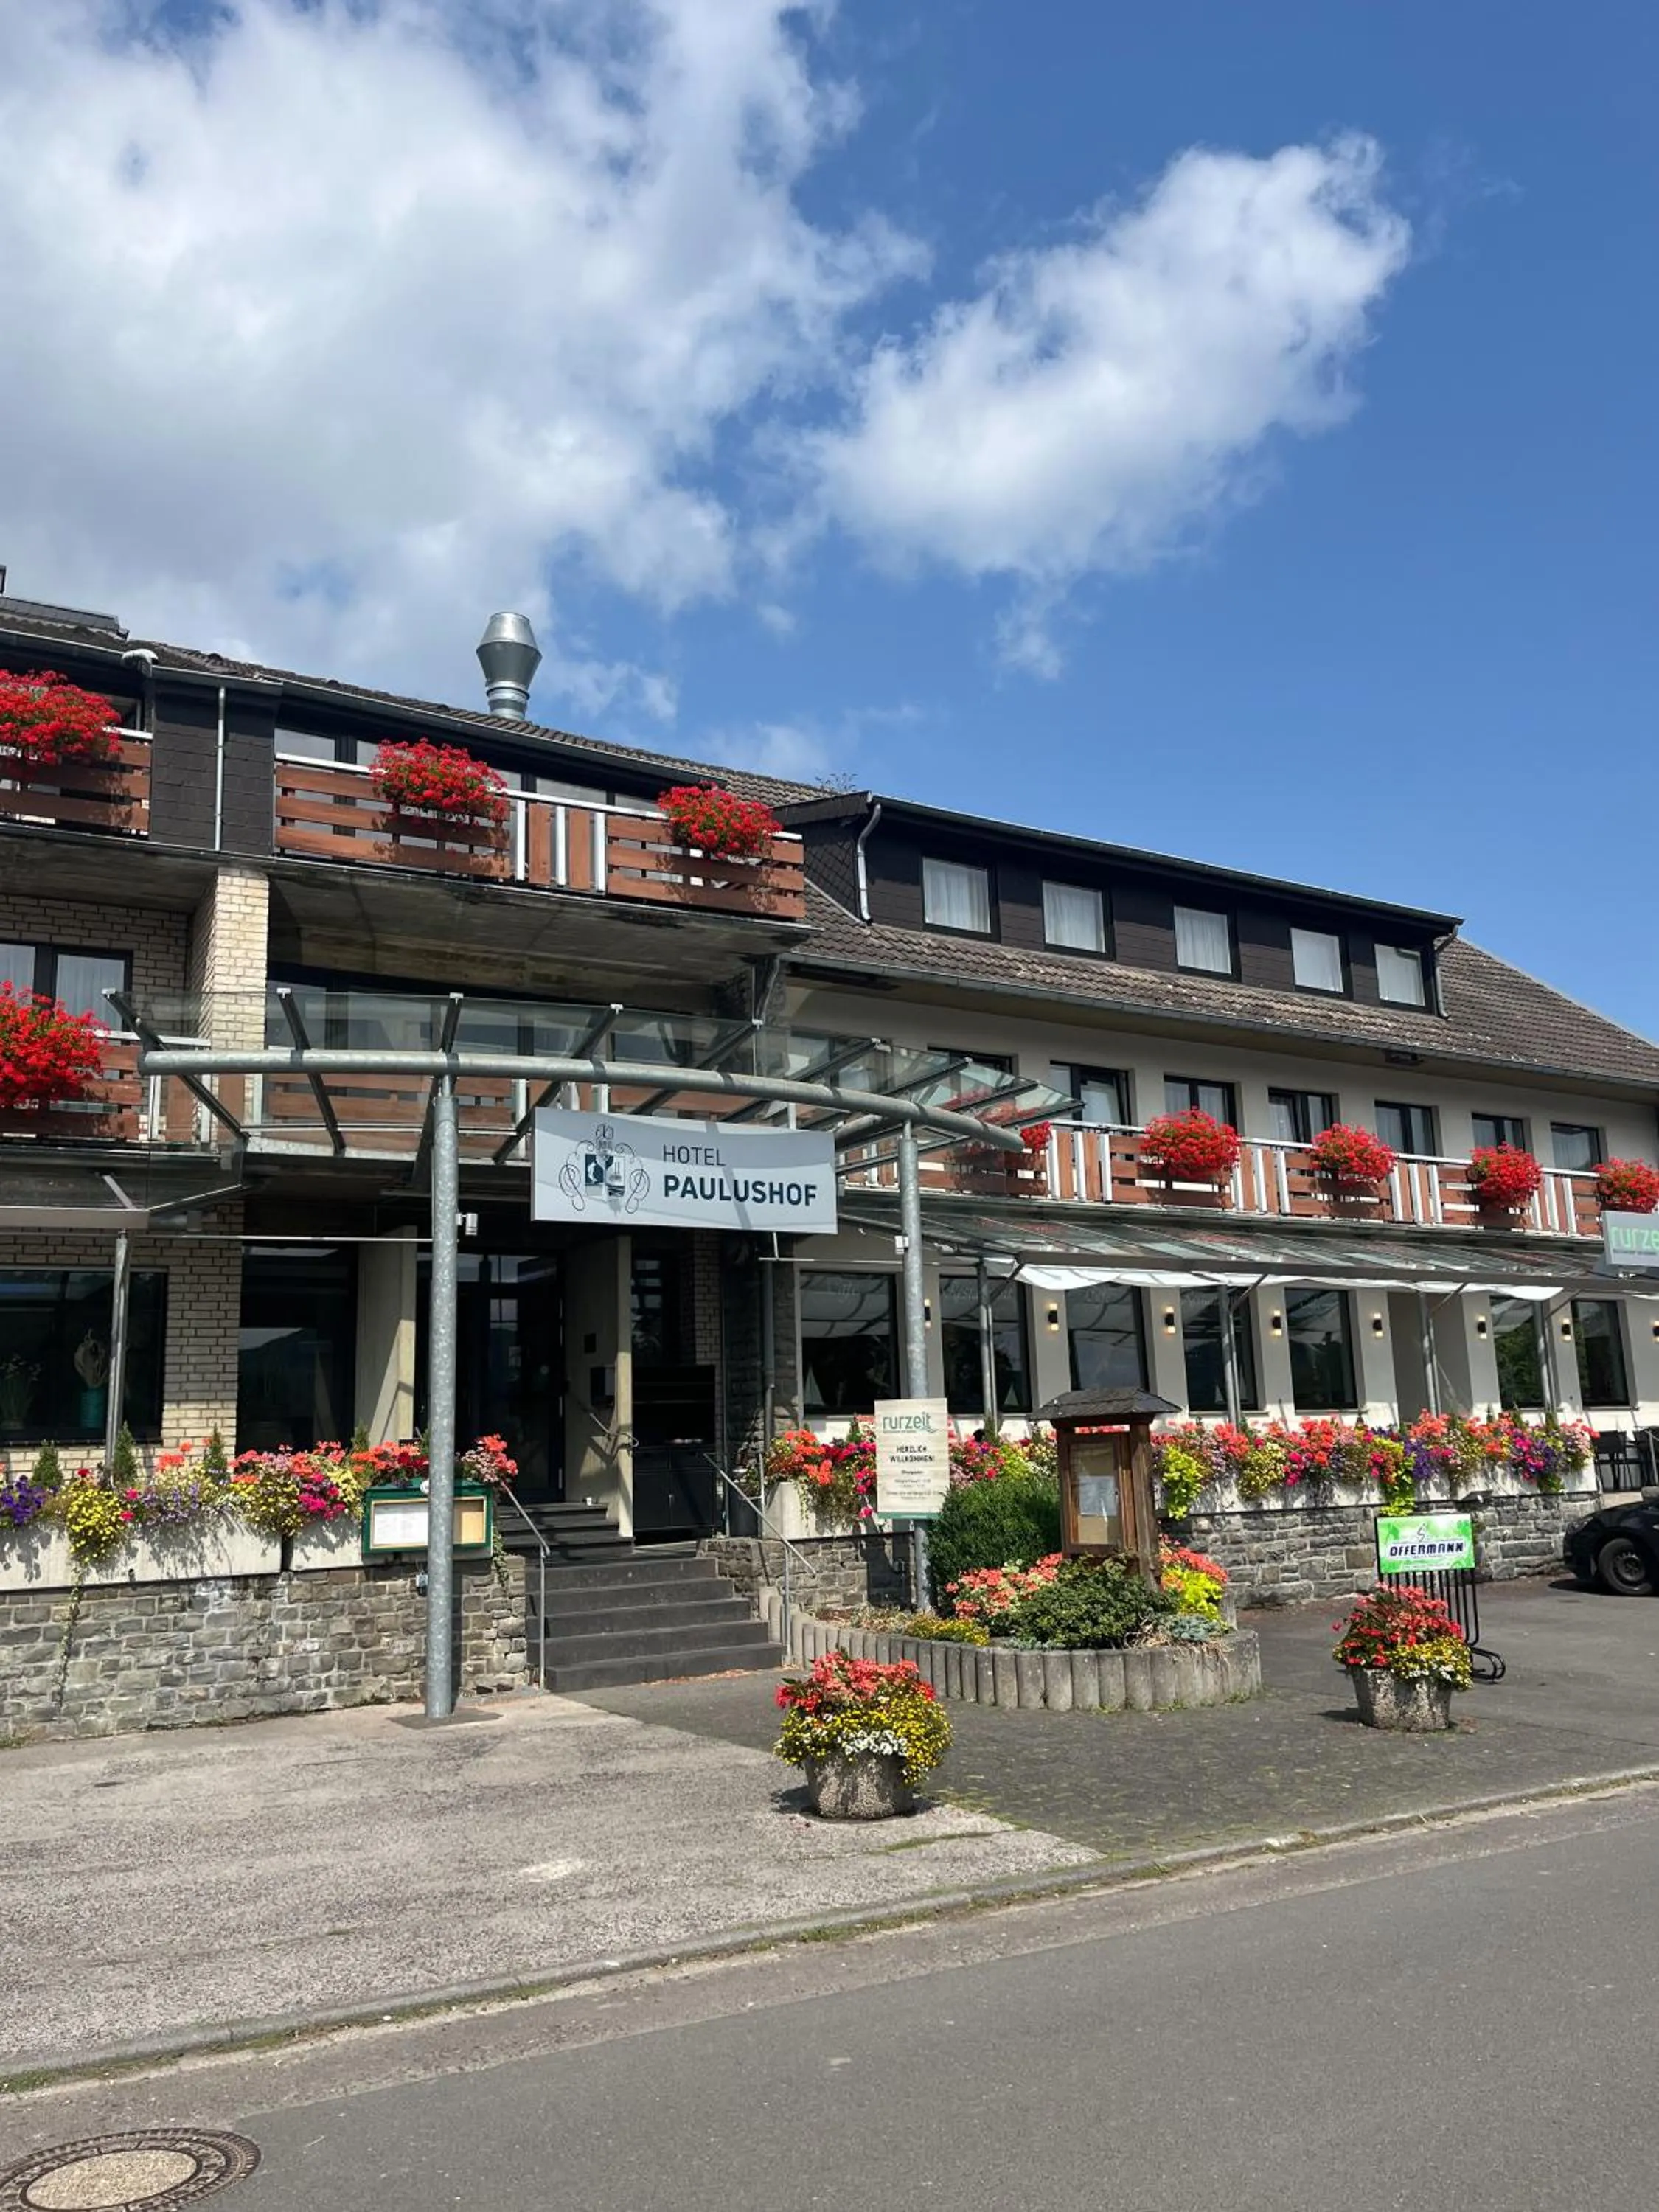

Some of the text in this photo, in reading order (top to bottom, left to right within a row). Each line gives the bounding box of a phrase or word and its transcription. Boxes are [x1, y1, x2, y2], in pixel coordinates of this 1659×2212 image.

[663, 1145, 726, 1167] HOTEL
[663, 1175, 817, 1207] PAULUSHOF
[883, 1411, 933, 1431] rurzeit
[896, 1445, 927, 1453] HERZLICH
[1389, 1542, 1464, 1557] OFFERMANN
